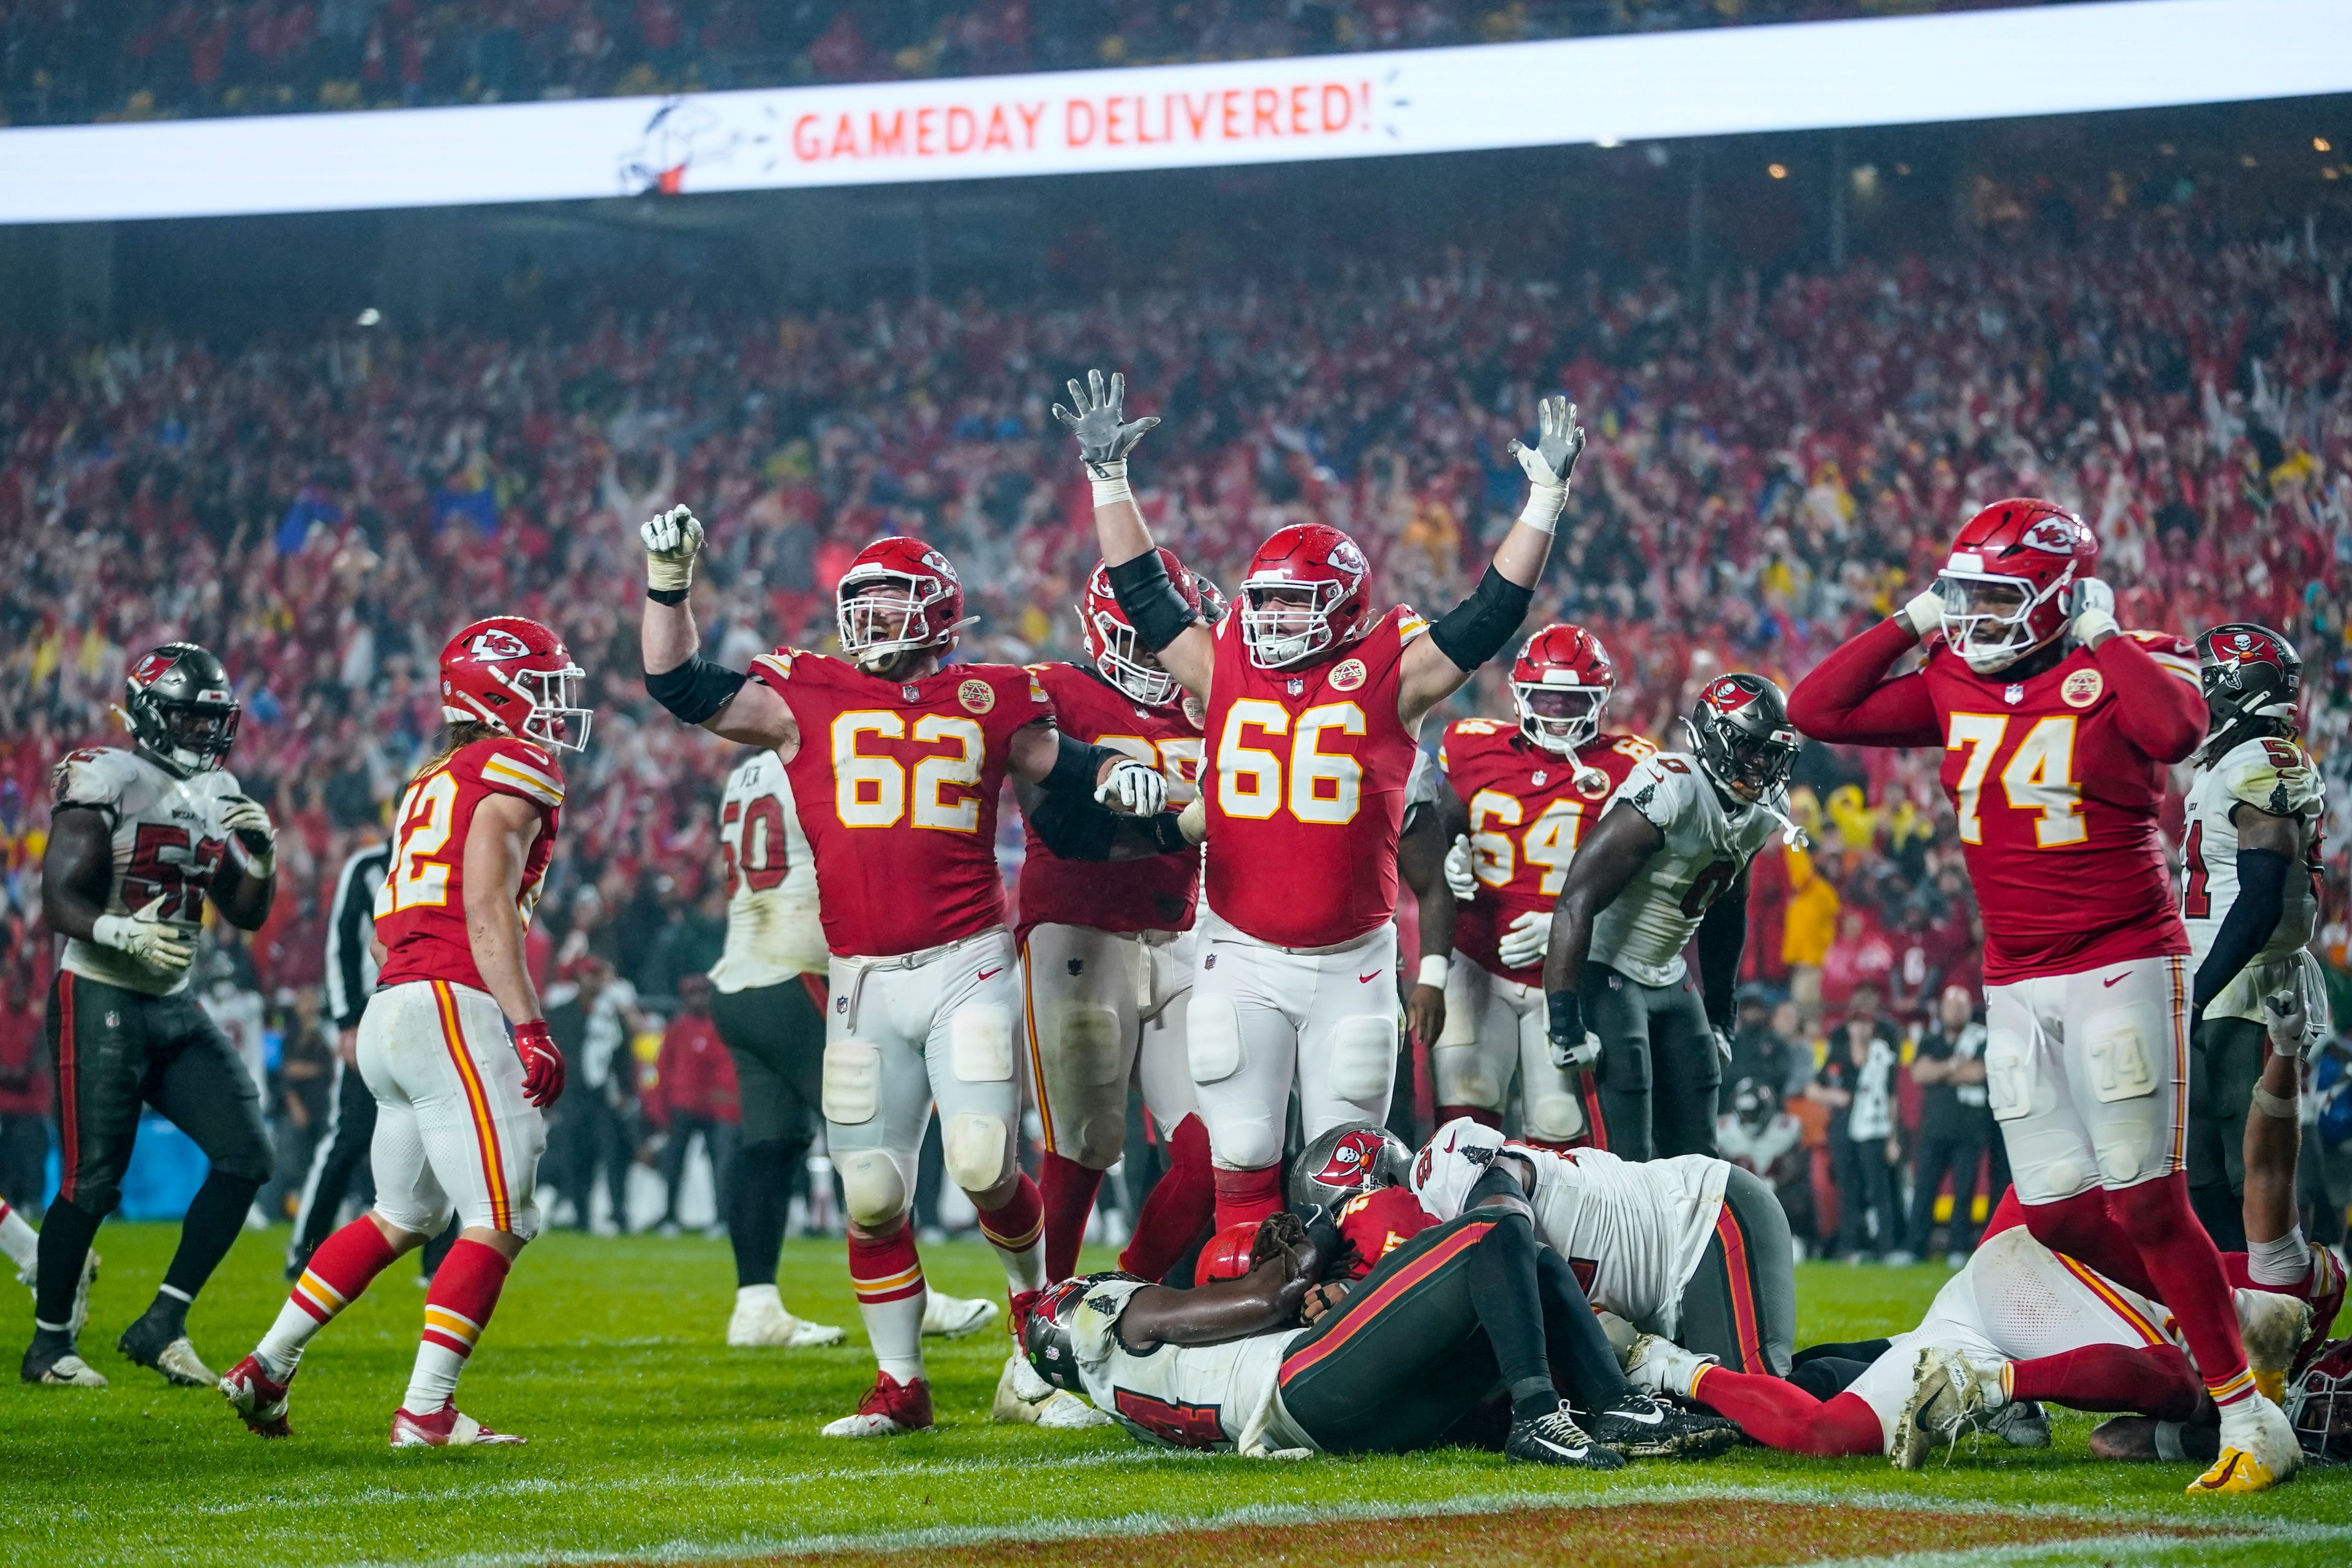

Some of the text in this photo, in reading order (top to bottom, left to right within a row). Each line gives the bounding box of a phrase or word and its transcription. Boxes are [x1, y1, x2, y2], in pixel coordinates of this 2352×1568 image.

[792, 80, 1370, 162] GAMEDAY DELIVERED!
[483, 635, 522, 657] KC
[831, 709, 986, 833] 62
[1216, 698, 1366, 825] 66
[1947, 712, 2089, 849] 74
[1470, 788, 1585, 896] 64
[2182, 820, 2212, 919] 1
